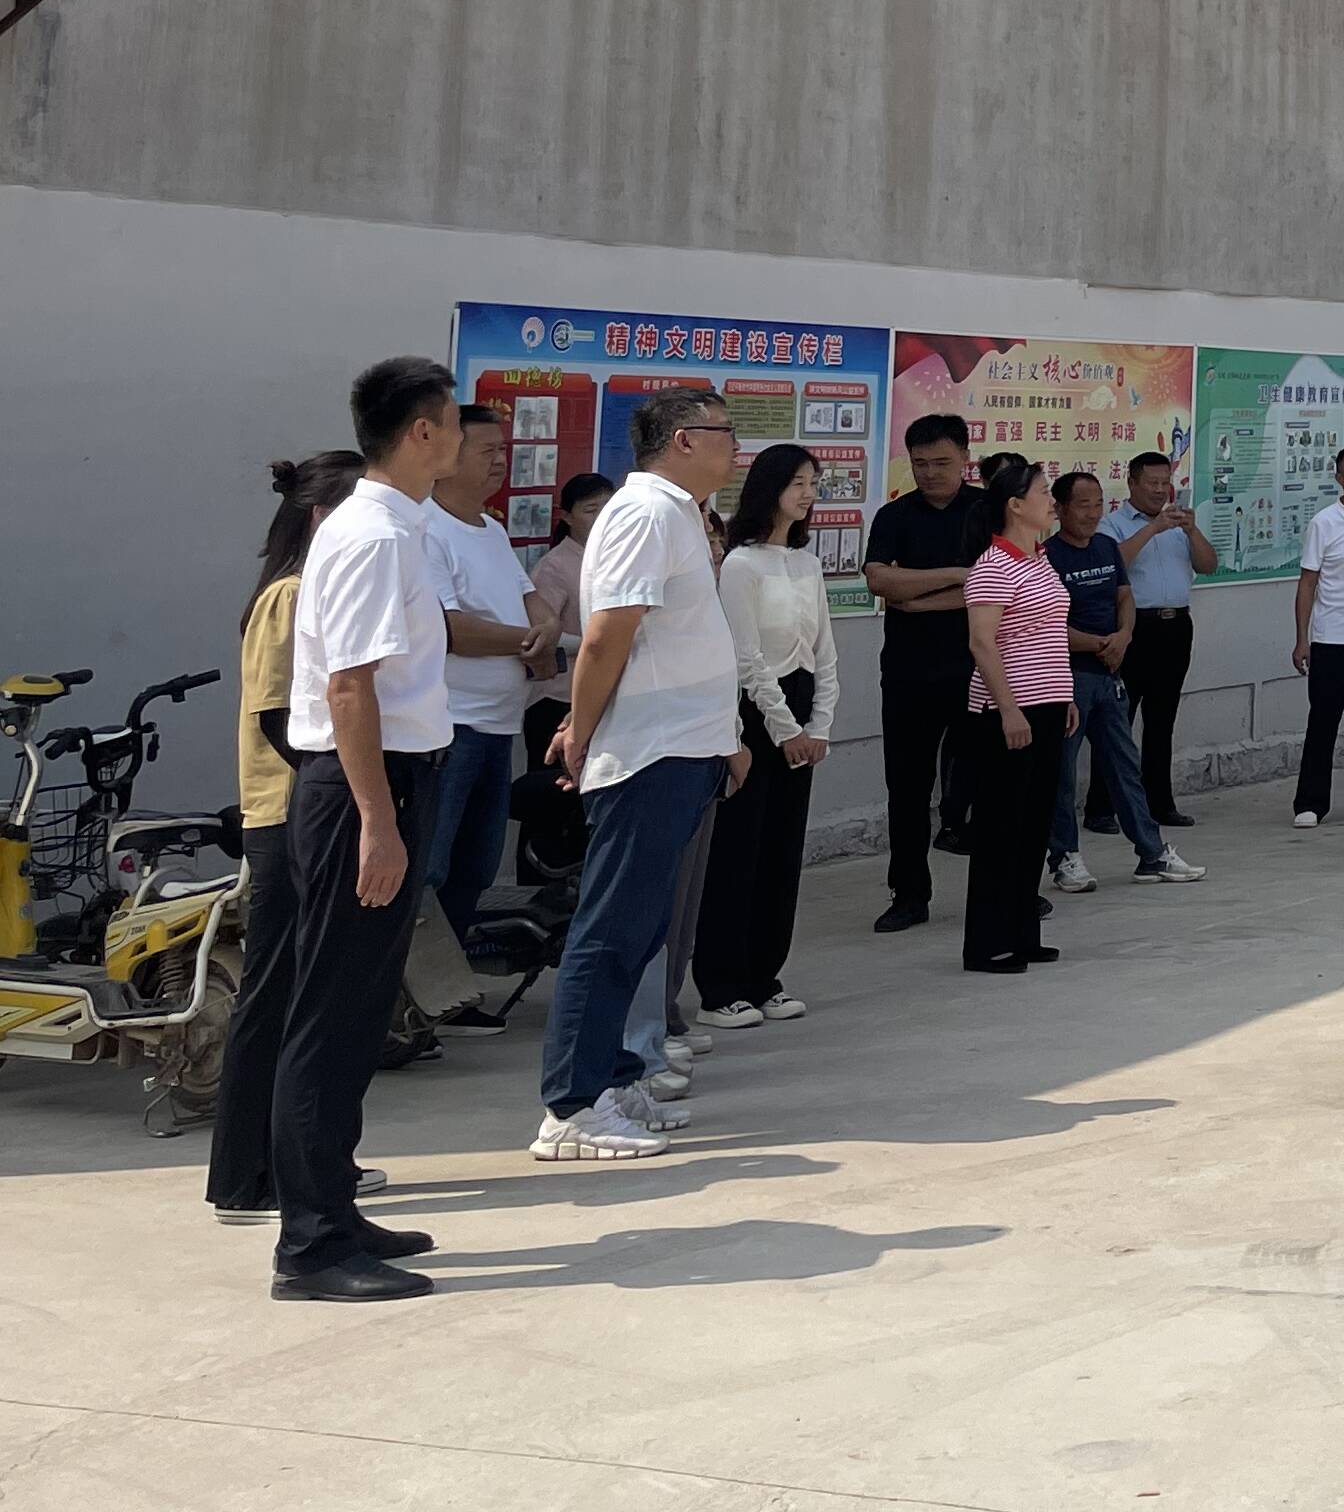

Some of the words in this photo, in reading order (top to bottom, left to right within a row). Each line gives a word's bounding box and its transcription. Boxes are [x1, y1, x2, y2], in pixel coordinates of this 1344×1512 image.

[605, 322, 844, 366] 精神文明建设宣传栏
[987, 354, 1115, 385] 社会主义核心价值观
[995, 421, 1023, 442] 富强
[1036, 422, 1062, 442] 民主
[1075, 422, 1100, 442] 文明
[1111, 422, 1136, 442] 和谐
